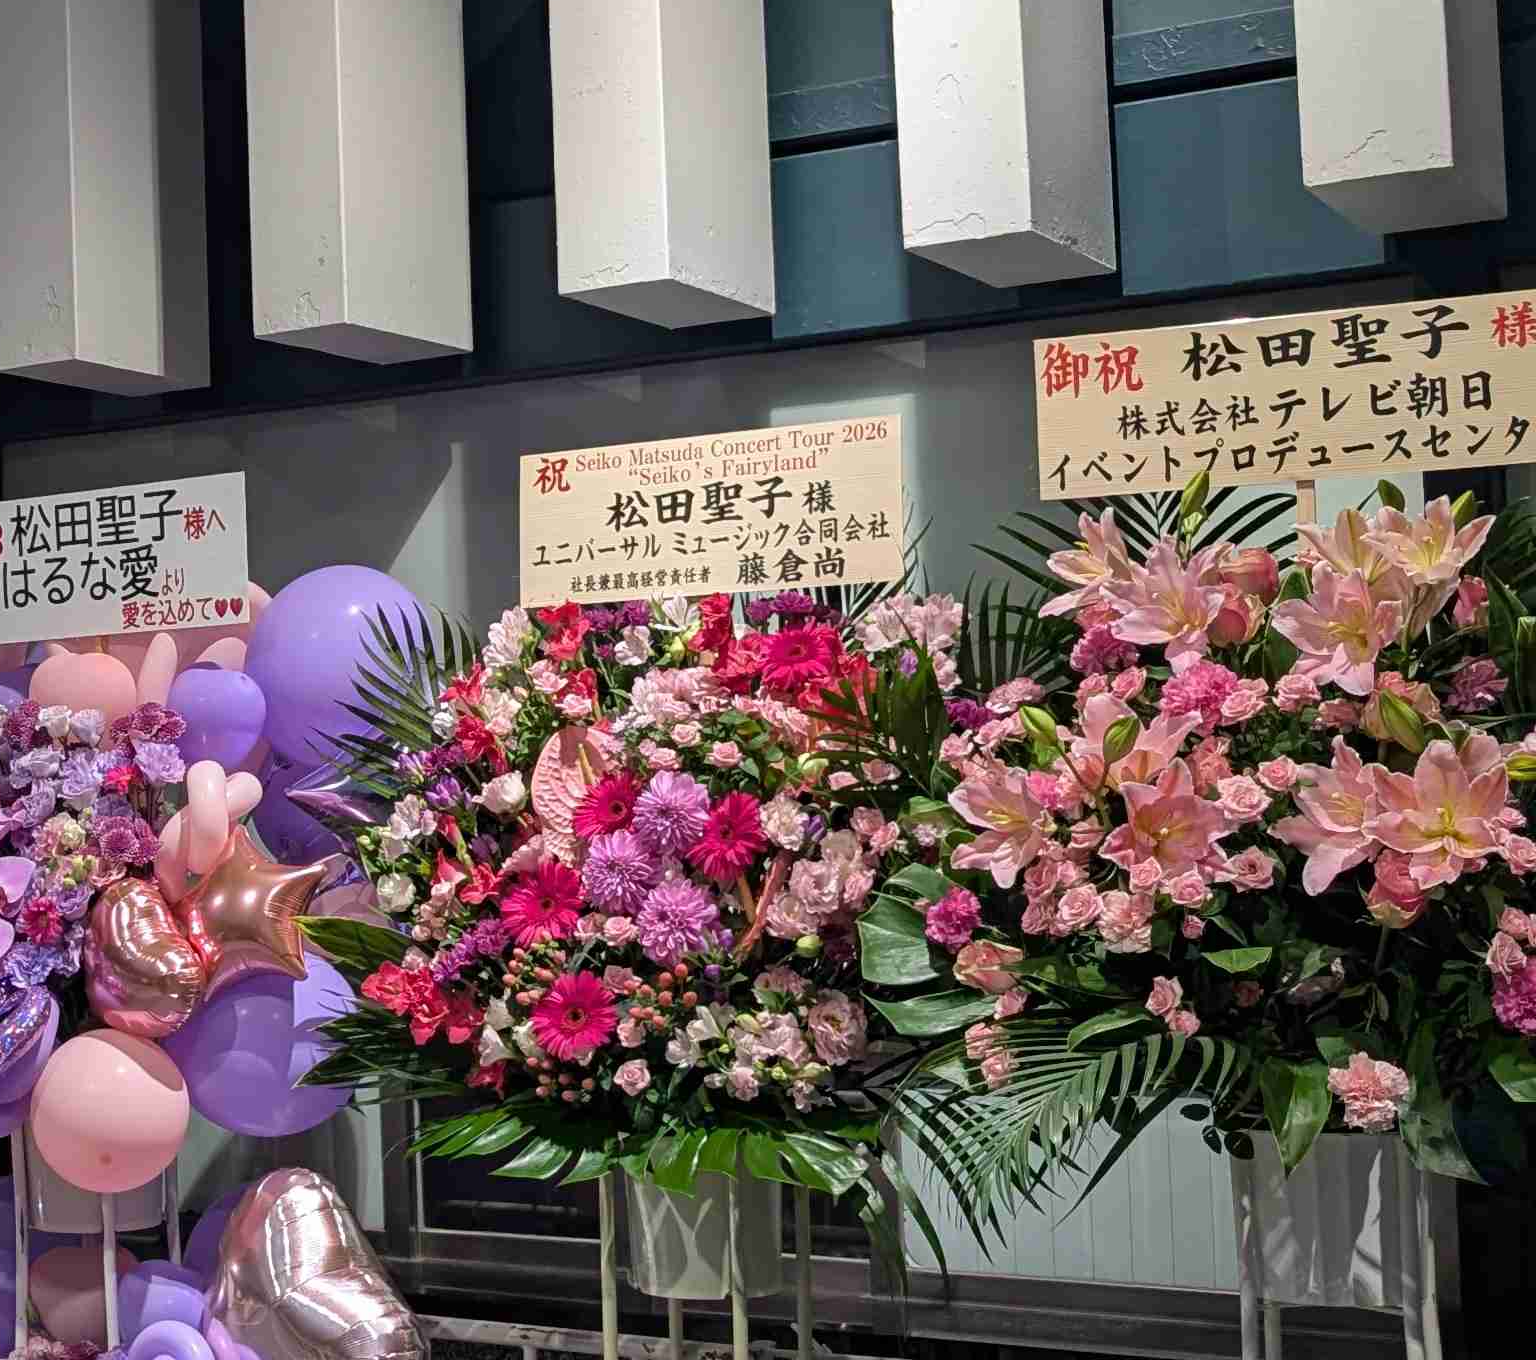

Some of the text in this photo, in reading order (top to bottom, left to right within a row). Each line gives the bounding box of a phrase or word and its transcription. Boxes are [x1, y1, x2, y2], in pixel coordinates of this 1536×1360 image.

[1040, 300, 1536, 399] 御祝 松田聖子 様
[575, 420, 889, 474] Seiko Matsuda Concert Tour 2026
[531, 456, 572, 495] 祝
[605, 476, 836, 534] 松田聖子 様
[735, 545, 847, 586] 藤倉尚
